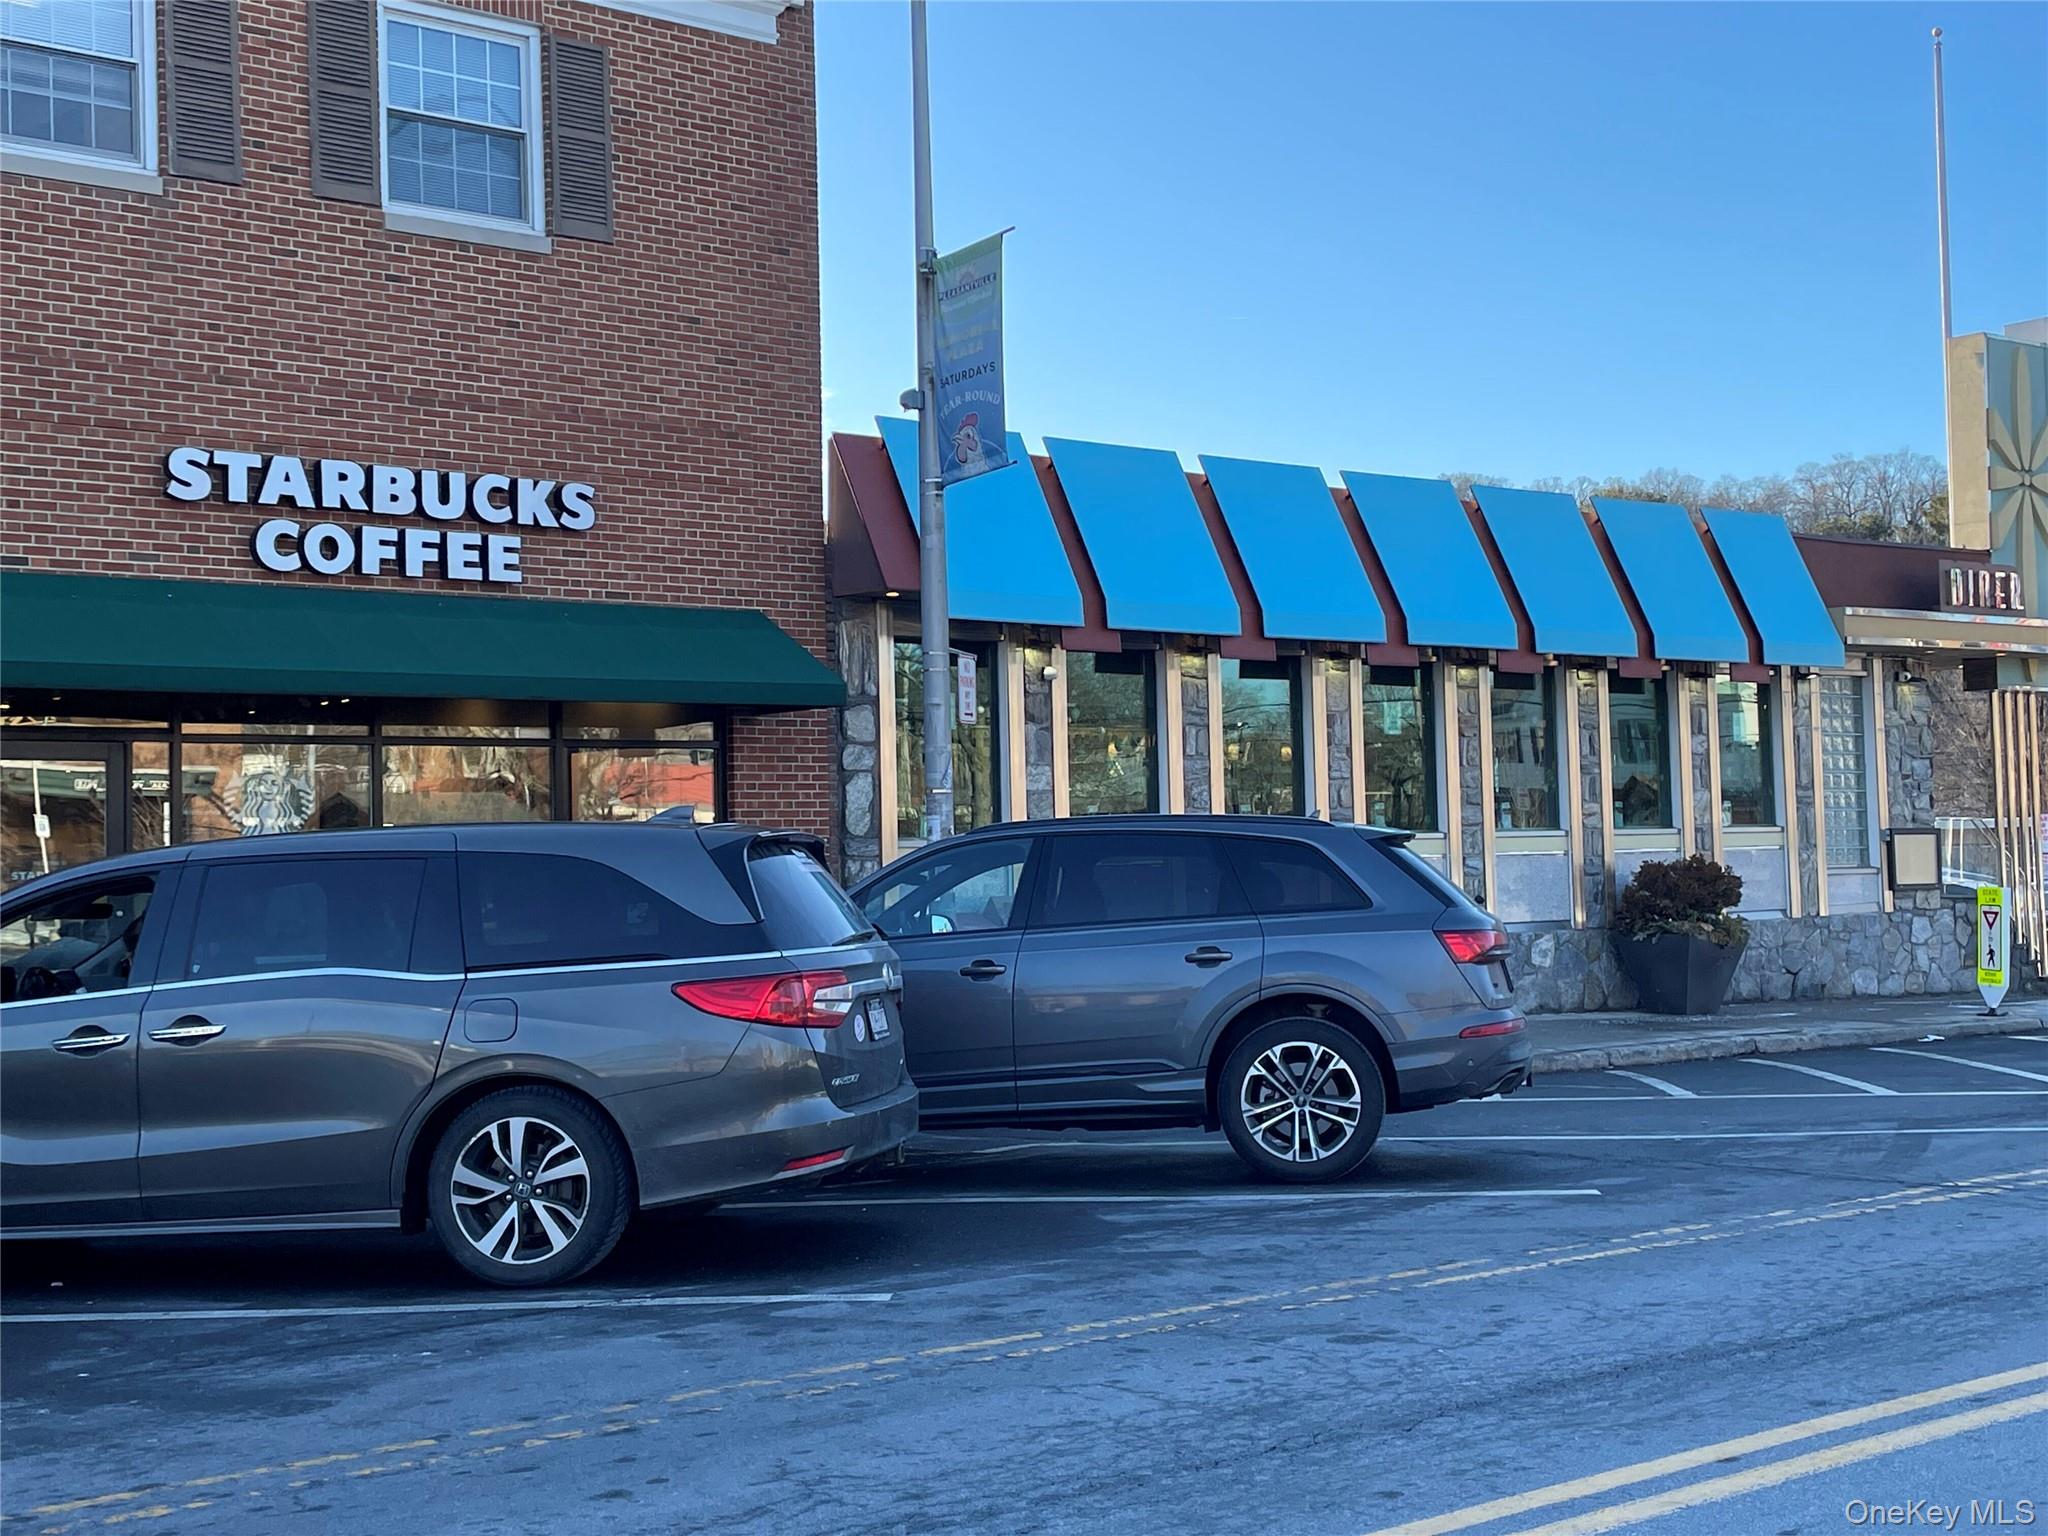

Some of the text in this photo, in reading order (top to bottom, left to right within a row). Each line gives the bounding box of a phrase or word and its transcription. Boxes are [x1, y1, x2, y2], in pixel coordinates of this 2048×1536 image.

[940, 361, 996, 389] SATURDAYS
[940, 390, 1001, 421] YEAR-ROUND
[165, 446, 596, 531] STARBUCKS
[252, 518, 523, 583] COFFEE
[1950, 567, 2024, 611] DINER
